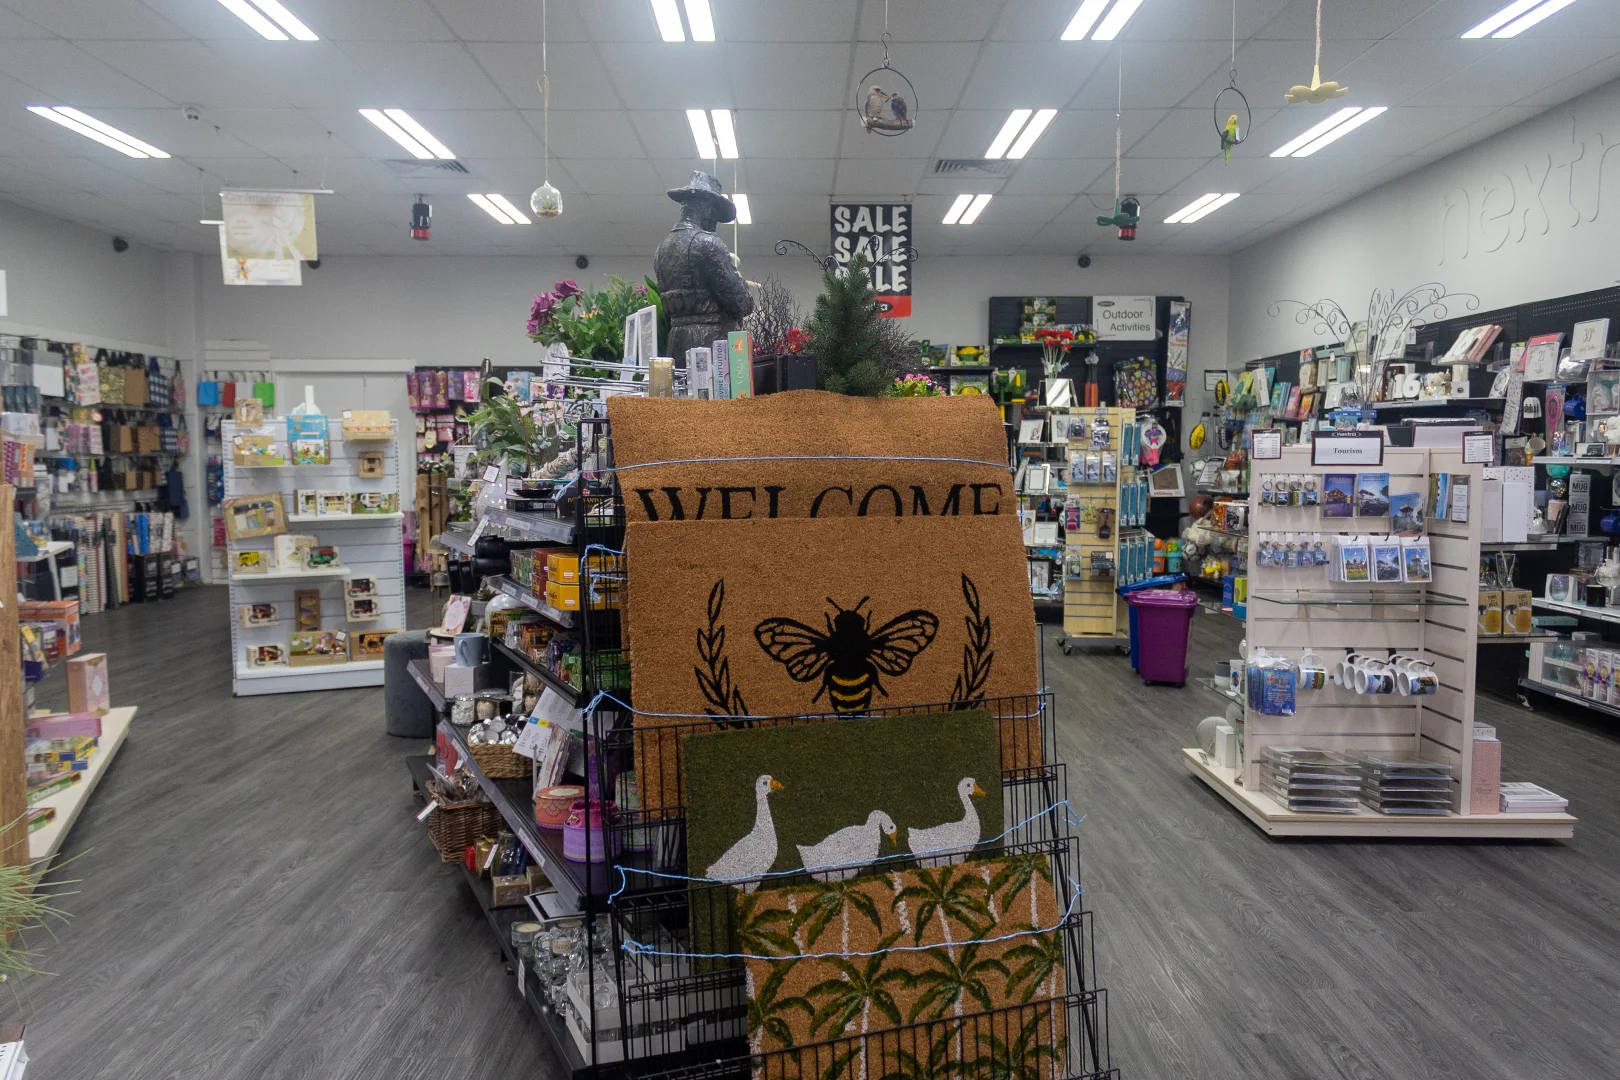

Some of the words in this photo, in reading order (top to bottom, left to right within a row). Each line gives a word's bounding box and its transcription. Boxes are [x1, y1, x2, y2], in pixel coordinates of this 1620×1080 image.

[834, 206, 908, 233] SALE
[834, 235, 908, 263] SALE
[1102, 309, 1144, 320] Outdoor
[1110, 323, 1151, 332] Activities
[1572, 482, 1588, 490] MUG
[1571, 503, 1587, 511] MUG
[1570, 524, 1586, 532] MUG
